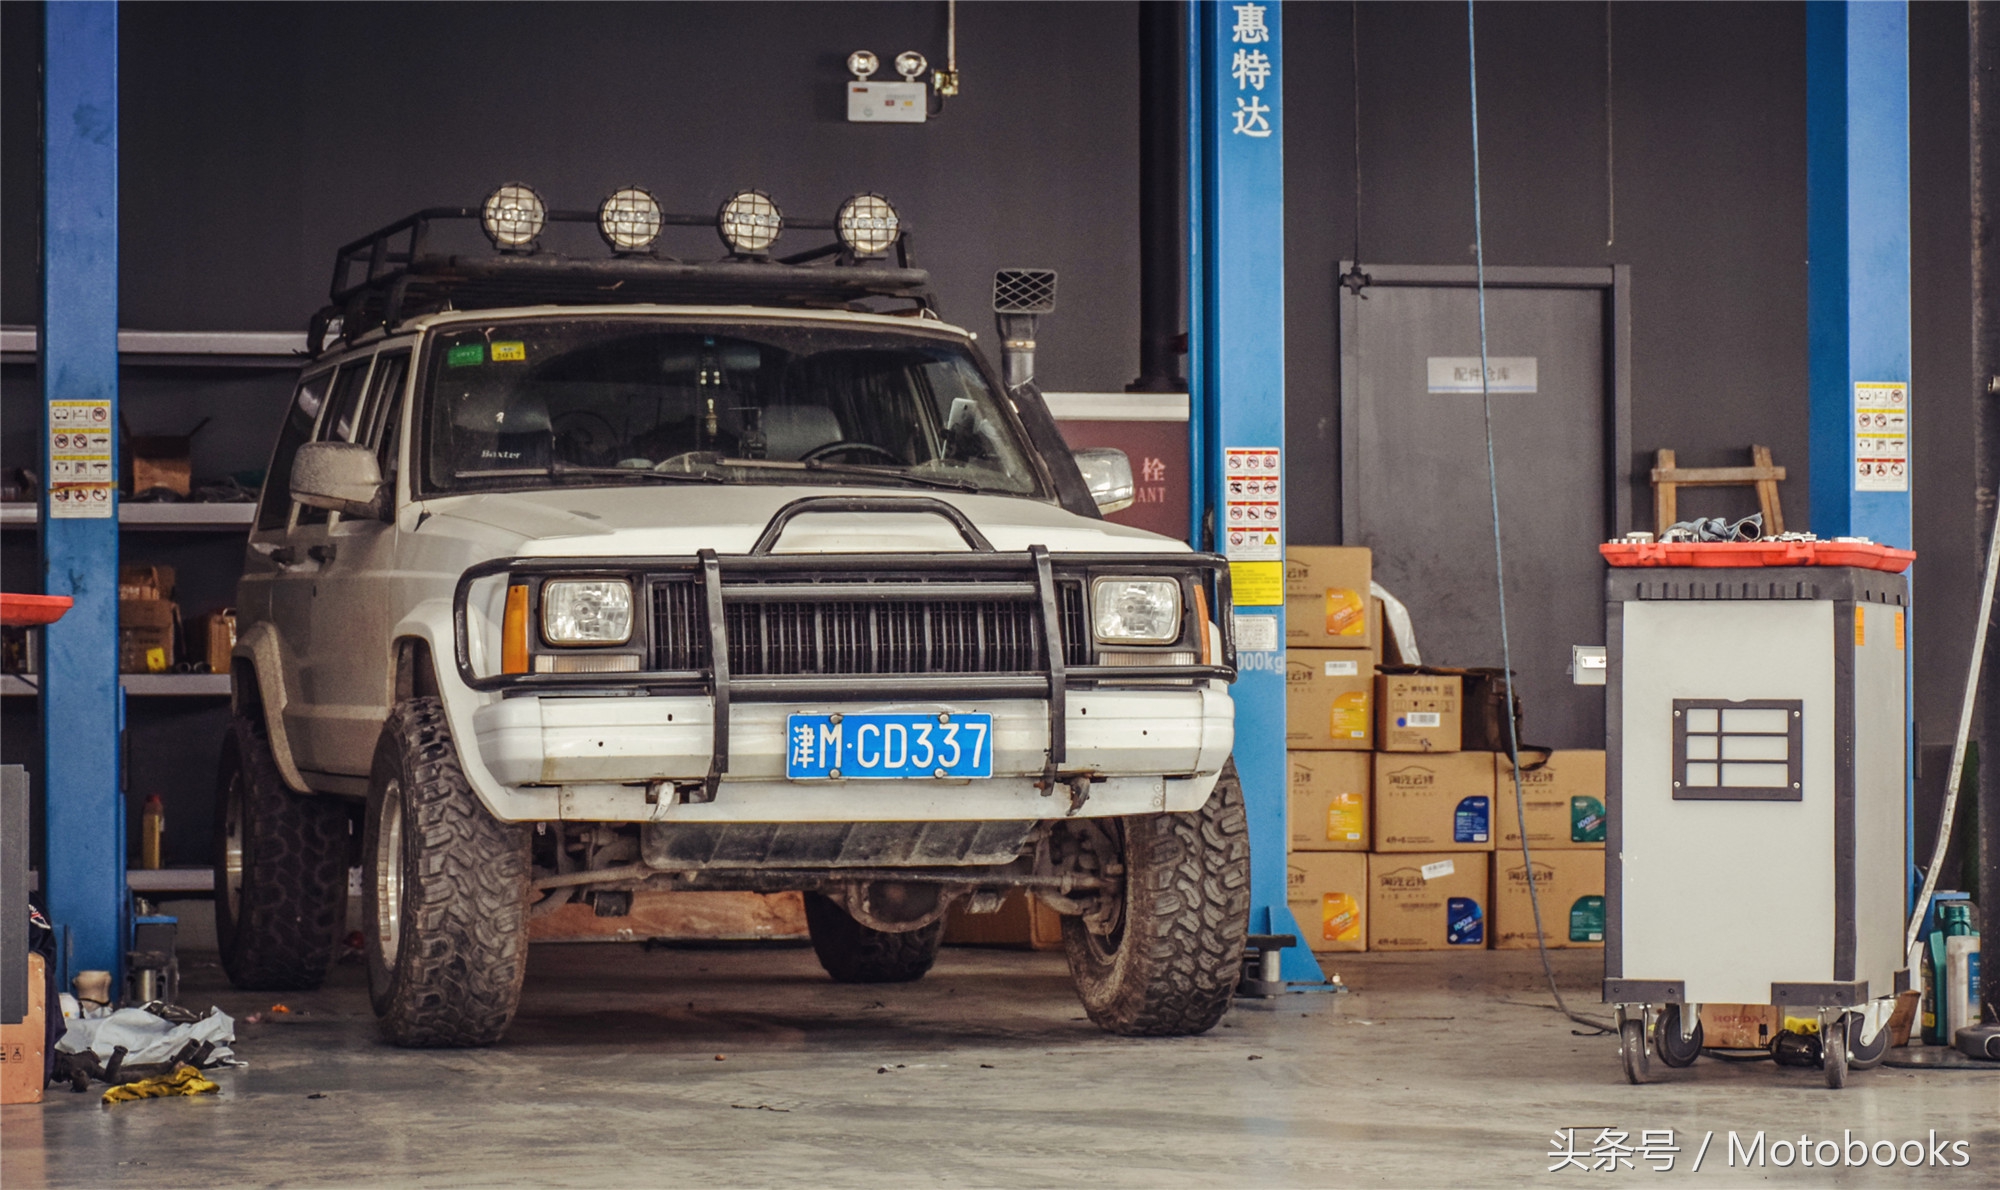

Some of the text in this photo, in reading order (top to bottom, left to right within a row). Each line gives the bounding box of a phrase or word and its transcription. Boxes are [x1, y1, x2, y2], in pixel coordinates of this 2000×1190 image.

[1231, 2, 1273, 138] 惠特达
[481, 449, 521, 459] Baxter
[1141, 457, 1166, 482] 栓
[1137, 487, 1166, 503] ANT
[792, 723, 988, 769] 津M·CD337
